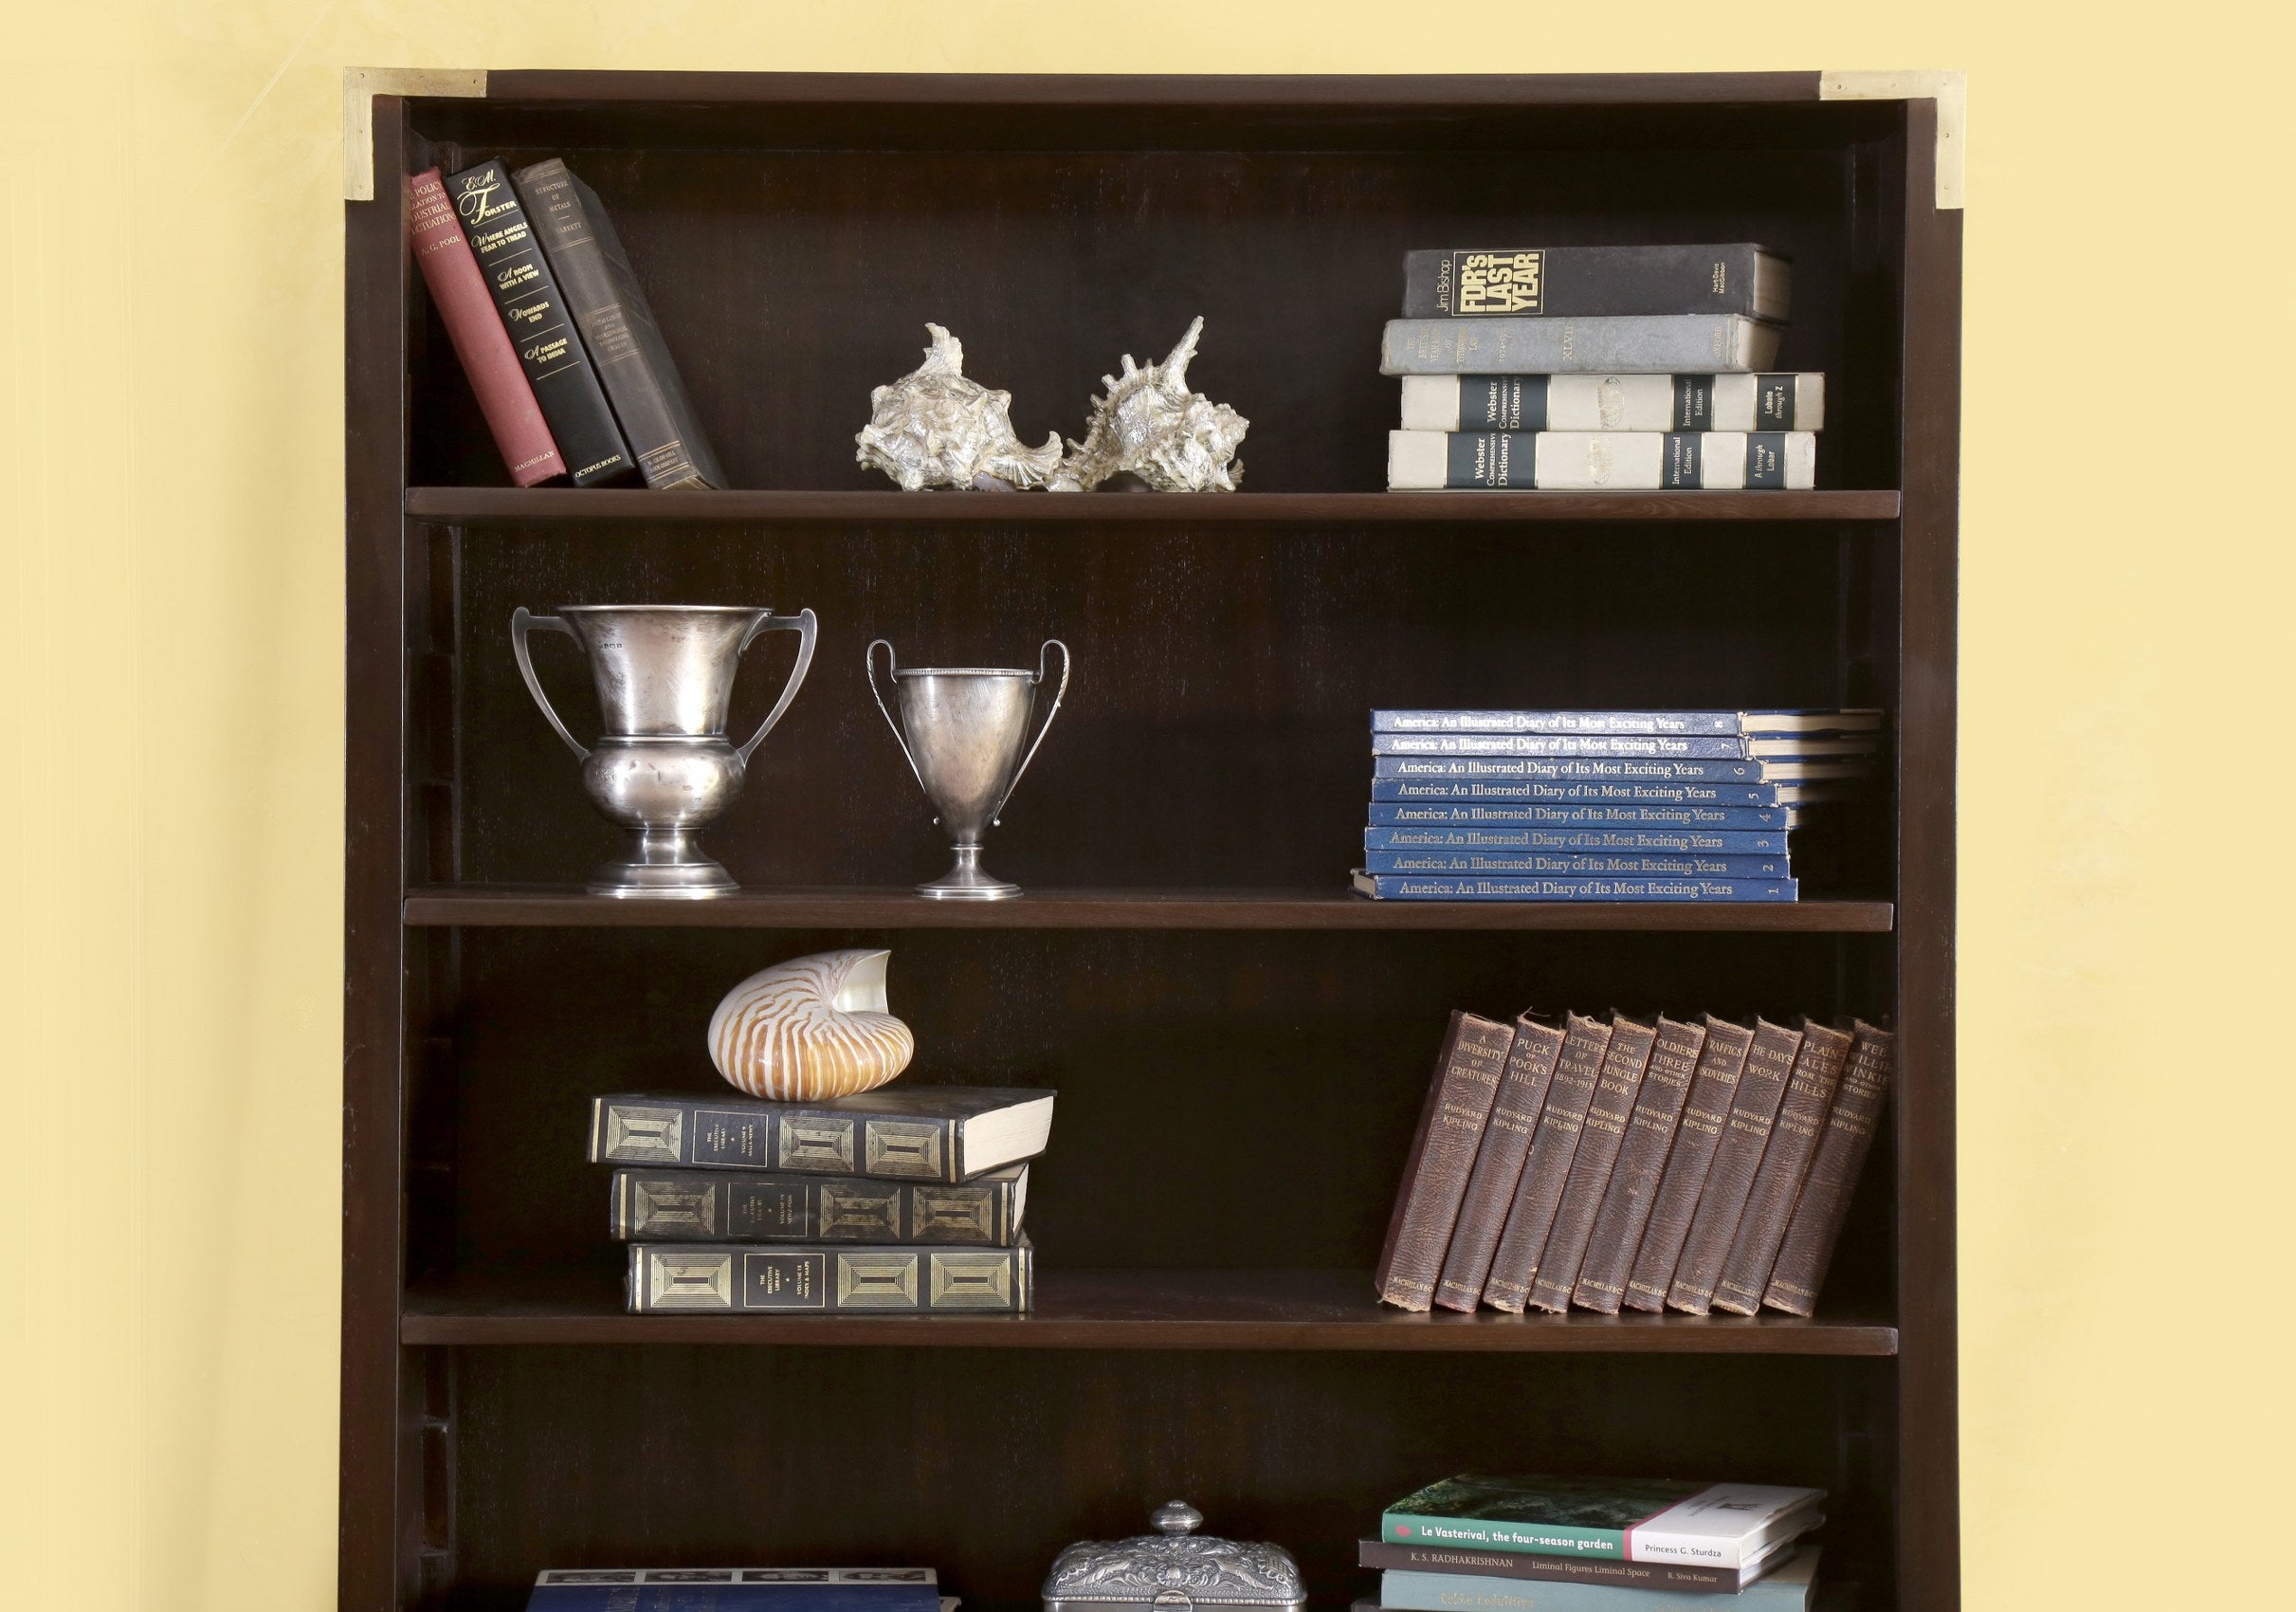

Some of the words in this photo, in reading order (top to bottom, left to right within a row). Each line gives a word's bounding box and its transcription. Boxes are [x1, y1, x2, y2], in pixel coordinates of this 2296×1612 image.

[457, 183, 517, 225] FORSTER
[440, 235, 461, 247] POOL
[471, 232, 503, 247] WHERE
[504, 222, 528, 233] ANGELS
[481, 245, 498, 254] FEAR
[507, 231, 527, 244] TREAD
[498, 267, 512, 282] A
[514, 264, 534, 276] ROOM
[500, 279, 518, 290] WITH
[522, 269, 539, 281] VIEW
[1437, 260, 1452, 293] Bishop
[1486, 255, 1514, 312] LAST
[1512, 253, 1540, 312] YEAR
[508, 302, 550, 321] HOWARDS
[1436, 294, 1449, 312] Jim
[529, 313, 542, 323] END
[525, 345, 539, 360] A
[540, 338, 568, 354] PASSAGE
[547, 348, 566, 359] INDIA
[1487, 381, 1498, 423] Webster
[1765, 391, 1774, 414] Lobate
[1776, 394, 1786, 419] through
[515, 450, 555, 472] MACMILLAN
[575, 463, 601, 478] OCTOPUS
[602, 454, 622, 468] BOOKS
[1475, 438, 1485, 480] Webster
[1499, 432, 1511, 486] Dictionary
[1672, 436, 1681, 485] International
[1756, 444, 1767, 472] through
[1767, 450, 1776, 471] Lobar
[1397, 761, 1447, 774] America:
[1449, 762, 1466, 774] An
[1468, 761, 1524, 774] Illustrated
[1527, 762, 1558, 778] Diary
[1561, 761, 1574, 774] of
[1576, 763, 1591, 774] Its
[1593, 763, 1621, 774] Most
[1625, 763, 1672, 778] Exciting
[1673, 763, 1704, 776] Years
[1733, 767, 1745, 776] 6
[1398, 784, 1449, 796] America:
[1450, 784, 1467, 796] An
[1471, 783, 1530, 797] Illustrated
[1534, 785, 1565, 799] Diary
[1568, 785, 1582, 797] of
[1583, 786, 1598, 797] Its
[1601, 786, 1631, 797] Most
[1634, 786, 1683, 801] Exciting
[1685, 787, 1716, 798] Years
[1394, 857, 1447, 869] America:
[1449, 857, 1467, 869] An
[1471, 857, 1532, 870] Illustrated
[1536, 858, 1570, 873] Diary
[1573, 859, 1587, 870] of
[1589, 859, 1604, 870] Its
[1608, 859, 1638, 870] Most
[1642, 859, 1692, 875] Exciting
[1694, 860, 1727, 871] Years
[1763, 864, 1774, 872] 2
[1399, 882, 1453, 894] America:
[1456, 883, 1474, 894] An
[1477, 882, 1540, 894] Illustrated
[1542, 883, 1576, 897] Diary
[1579, 882, 1594, 894] of
[1595, 883, 1611, 894] Its
[1613, 883, 1645, 894] Most
[1648, 883, 1699, 899] Exciting
[1701, 884, 1733, 895] Years
[1480, 1035, 1486, 1044] A
[1517, 1037, 1550, 1055] PUCK
[1565, 1035, 1606, 1053] LETTERS
[1618, 1043, 1636, 1054] THE
[1458, 1041, 1503, 1060] DIVERSITY
[1576, 1052, 1588, 1060] OF
[1804, 1040, 1839, 1059] PLAIN
[1862, 1041, 1887, 1057] WEE
[1471, 1059, 1483, 1068] OF
[1509, 1056, 1548, 1075] POOK'S
[1559, 1059, 1597, 1077] TRAVEL
[1606, 1051, 1643, 1069] SECOND
[1653, 1053, 1690, 1072] THREE
[1712, 1057, 1727, 1067] AND
[1451, 1066, 1497, 1086] CREATURES
[1510, 1071, 1538, 1087] HILL
[1601, 1064, 1638, 1083] JUNGLE
[1649, 1072, 1681, 1088] STORIES
[1748, 1063, 1780, 1082] WORK
[1601, 1078, 1630, 1095] BOOK
[1791, 1079, 1827, 1099] HILLS
[1843, 1083, 1876, 1099] STORIES
[1445, 1103, 1483, 1120] RUDYARD
[1496, 1107, 1533, 1123] RUDYARD
[1546, 1105, 1584, 1121] RUDYARD
[1590, 1106, 1626, 1124] RUDYARD
[1635, 1105, 1673, 1123] RUDYARD
[1686, 1107, 1722, 1124] RUDYARD
[1733, 1107, 1771, 1125] RUDYARD
[1782, 1108, 1819, 1126] RUDYARD
[1832, 1107, 1871, 1124] RUDYARD
[1443, 1115, 1479, 1131] KIPLING
[1493, 1118, 1528, 1134] KIPLING
[1543, 1115, 1579, 1133] KIPLING
[1586, 1117, 1621, 1134] KIPLING
[1634, 1117, 1668, 1133] KIPLING
[1683, 1118, 1718, 1135] KIPLING
[1730, 1118, 1767, 1136] KIPLING
[1779, 1120, 1814, 1137] KIPLING
[1831, 1118, 1867, 1135] KIPLING
[1422, 1526, 1433, 1536] Le
[1435, 1528, 1489, 1543] Vasterival,
[1492, 1531, 1510, 1543] the
[1512, 1532, 1575, 1548] four-season
[1577, 1538, 1613, 1551] garden
[1411, 1552, 1420, 1563] K.
[1422, 1553, 1430, 1563] S.
[1431, 1554, 1514, 1567] RADHAKRISHNAN
[1646, 1545, 1678, 1554] Princess
[1691, 1548, 1722, 1558] Sturdza
[1532, 1562, 1563, 1571] Liminal
[1565, 1564, 1593, 1574] Figures
[1594, 1566, 1625, 1575] Liminal
[1627, 1568, 1650, 1579] Space
[1676, 1572, 1692, 1581] Siva
[1693, 1573, 1718, 1583] Kumar
